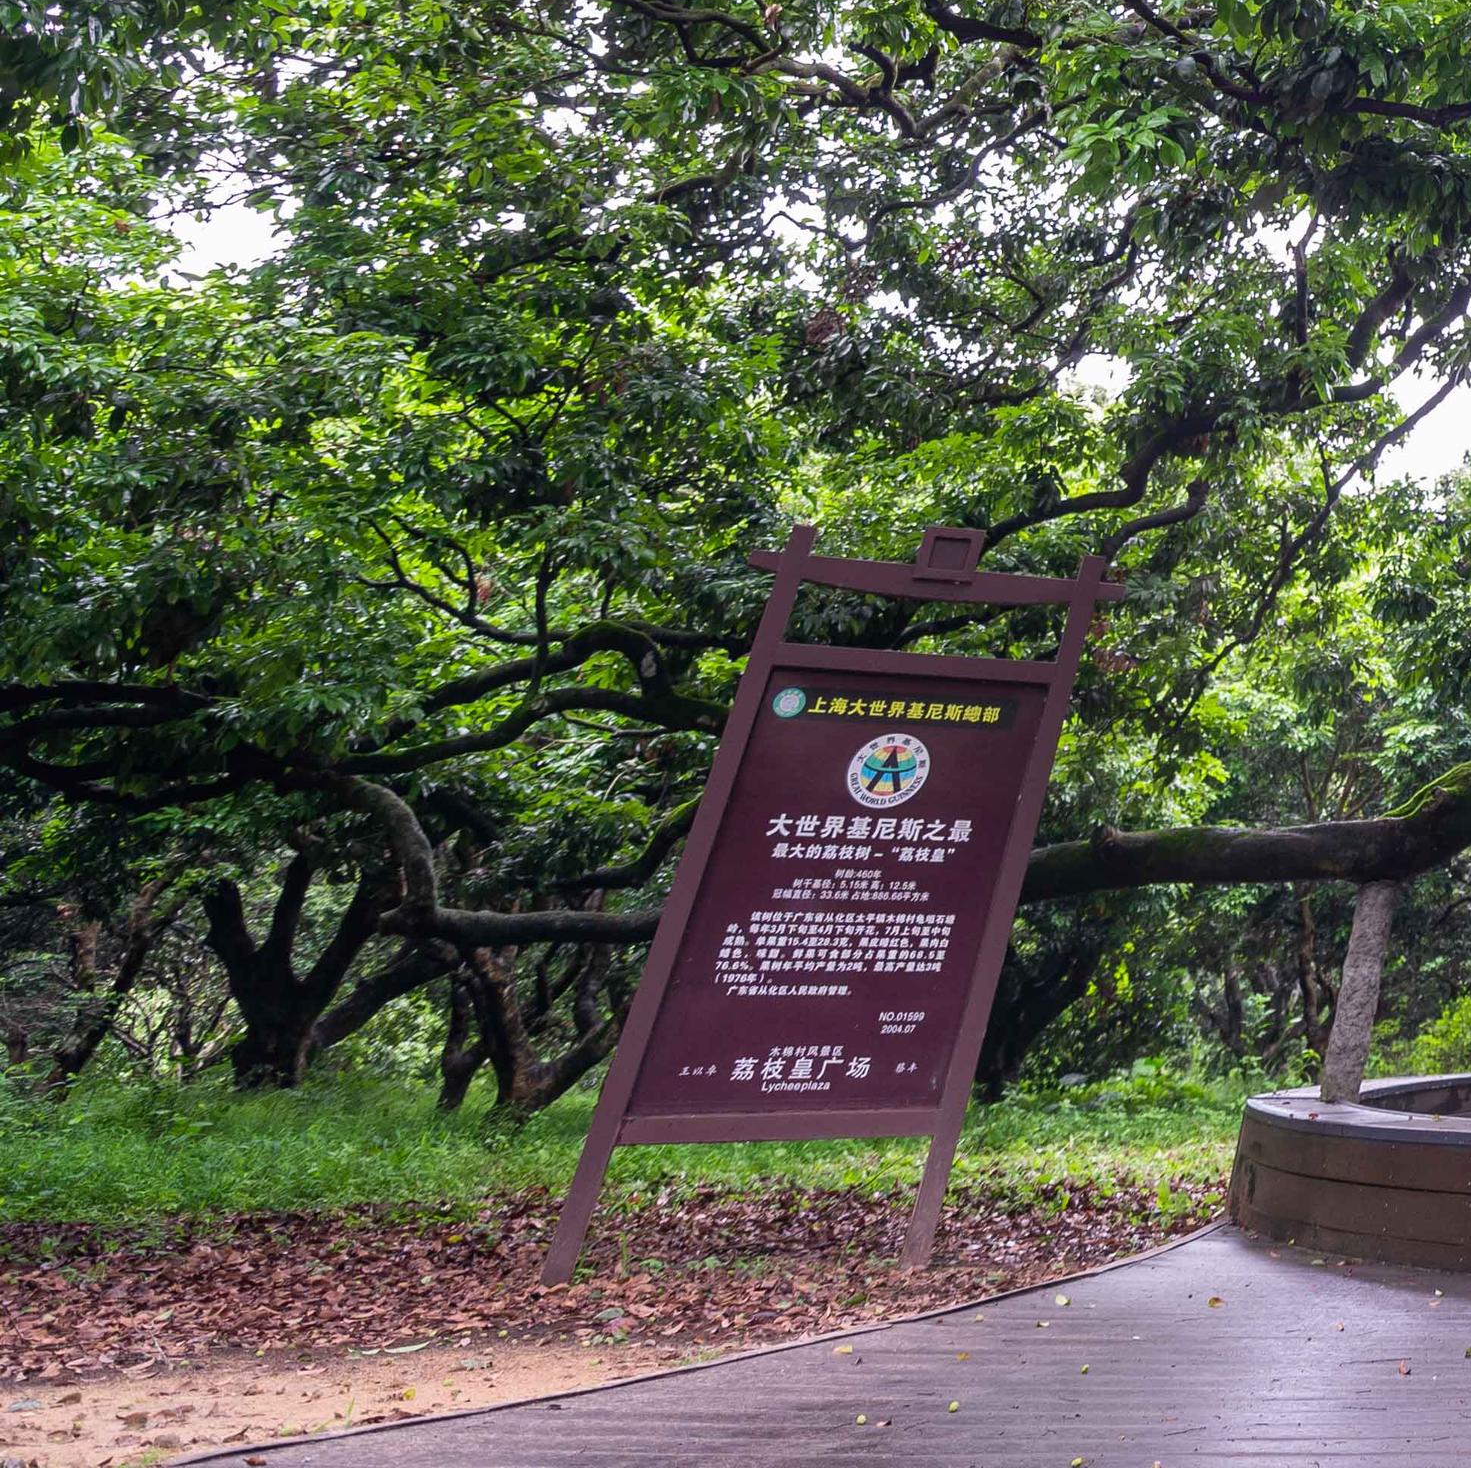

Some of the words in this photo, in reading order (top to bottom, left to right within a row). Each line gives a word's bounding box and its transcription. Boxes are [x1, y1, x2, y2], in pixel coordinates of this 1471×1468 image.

[808, 696, 1001, 723] 上海大世界基尼斯總部
[860, 793, 887, 805] WORLD
[888, 775, 923, 804] GUINNESS
[765, 812, 973, 843] 大世界基尼斯之最
[878, 1011, 925, 1022] NO.01599
[881, 1024, 916, 1034] 2004.07
[769, 1045, 843, 1057] 木棉村风景区
[730, 1056, 872, 1081] 荔枝皇广场
